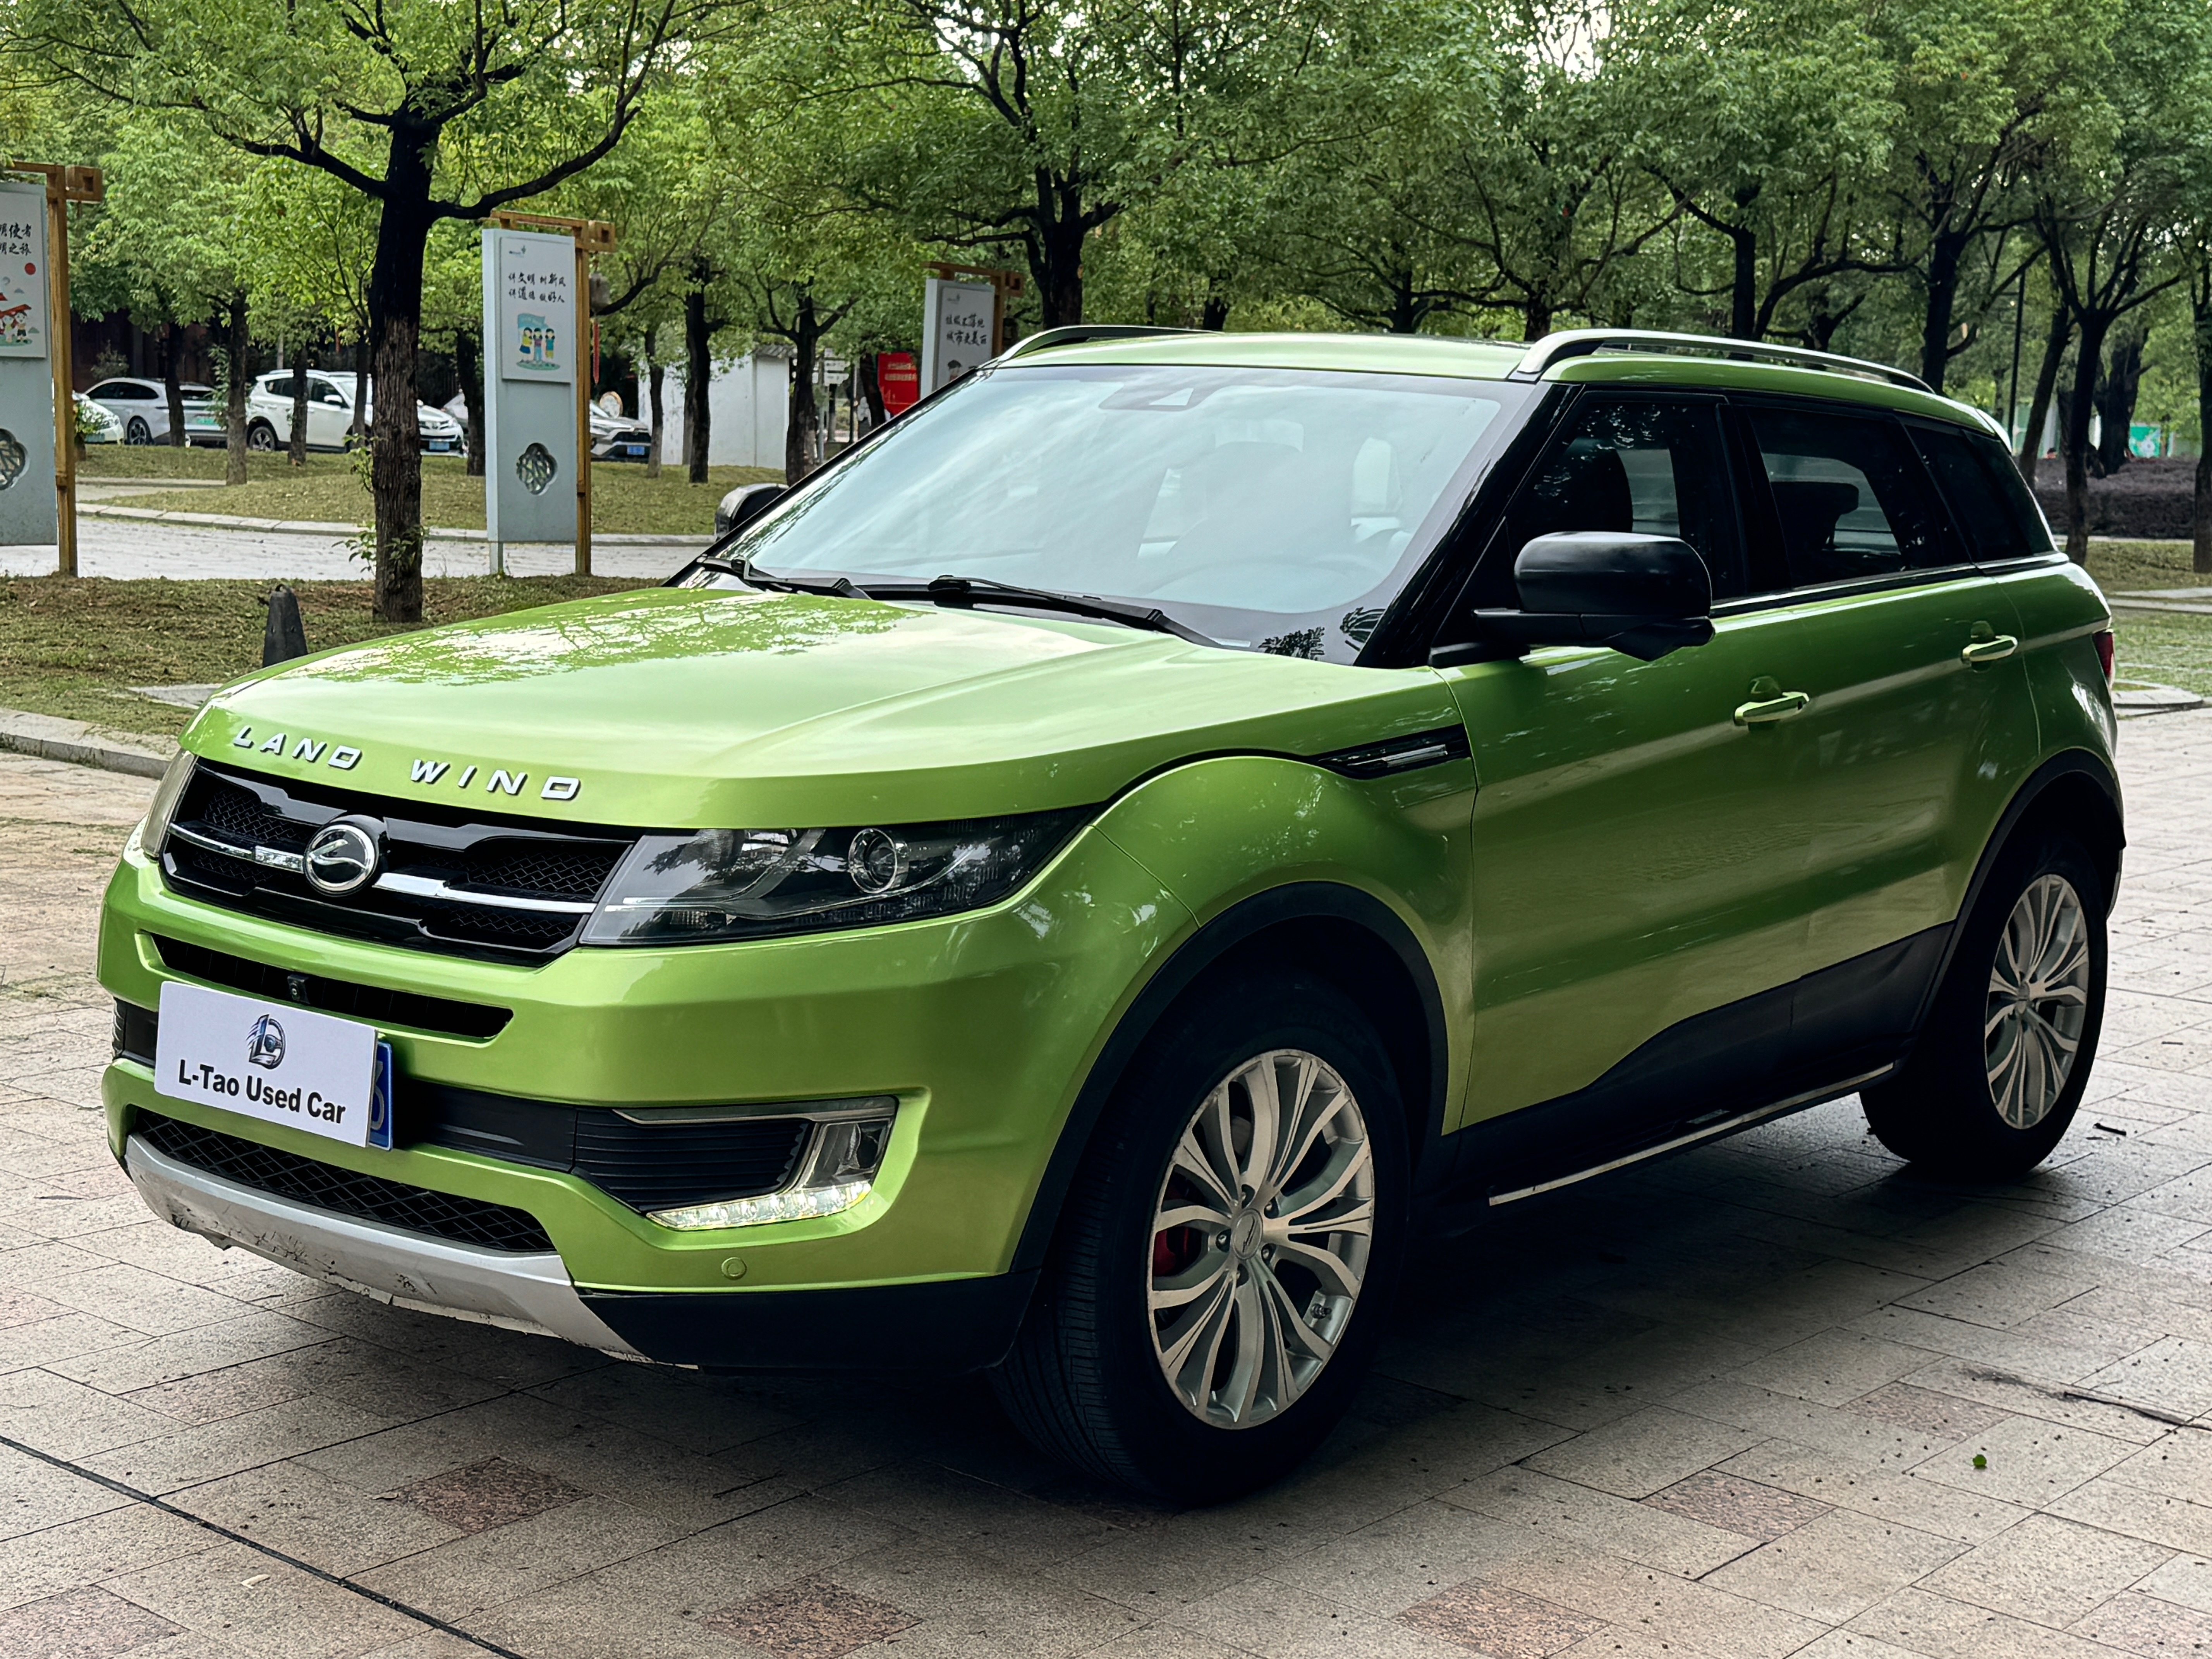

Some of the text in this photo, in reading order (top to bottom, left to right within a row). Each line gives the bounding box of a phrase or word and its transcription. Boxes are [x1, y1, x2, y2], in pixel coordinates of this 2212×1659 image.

[233, 725, 581, 800] LAND WIND
[179, 1059, 239, 1096] L-Tao
[246, 1075, 302, 1113] Used
[307, 1092, 346, 1123] Car
